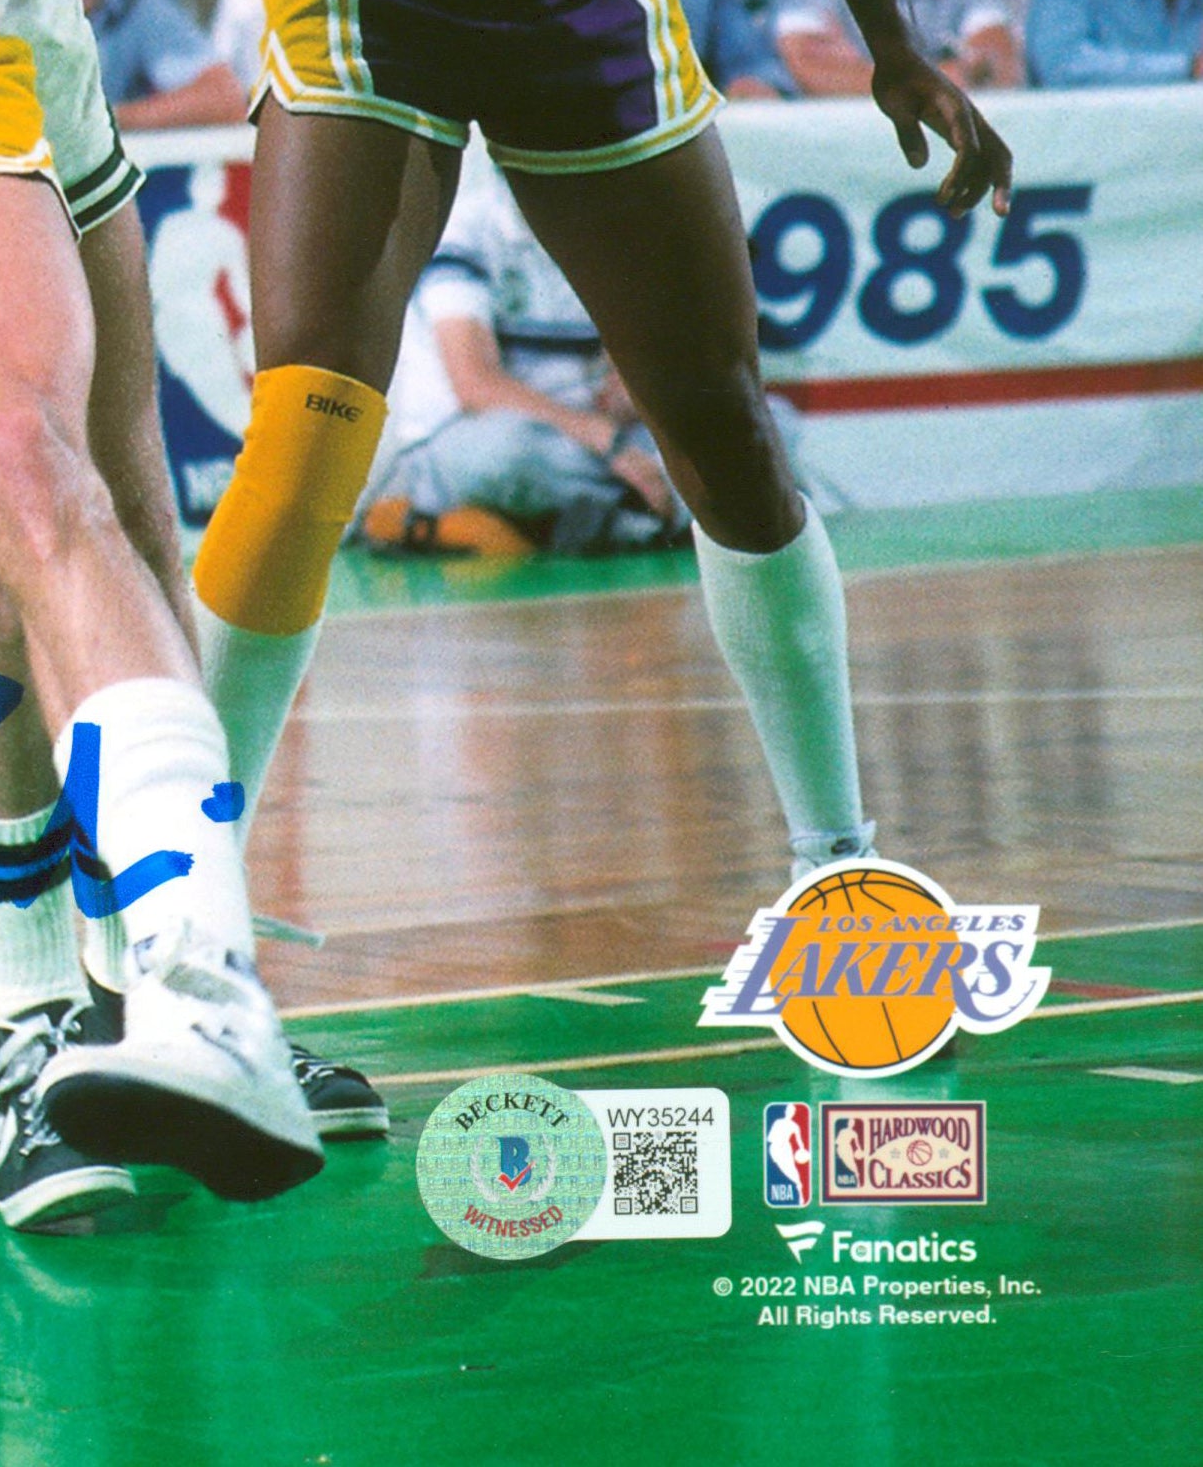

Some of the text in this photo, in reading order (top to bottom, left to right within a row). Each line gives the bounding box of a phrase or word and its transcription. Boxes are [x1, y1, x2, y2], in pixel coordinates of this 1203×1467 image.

[747, 184, 1096, 352] 985
[305, 393, 363, 423] BIKE
[454, 1091, 570, 1132] BECKETT
[607, 1107, 715, 1127] WY35244
[464, 1204, 564, 1238] WITNESSED
